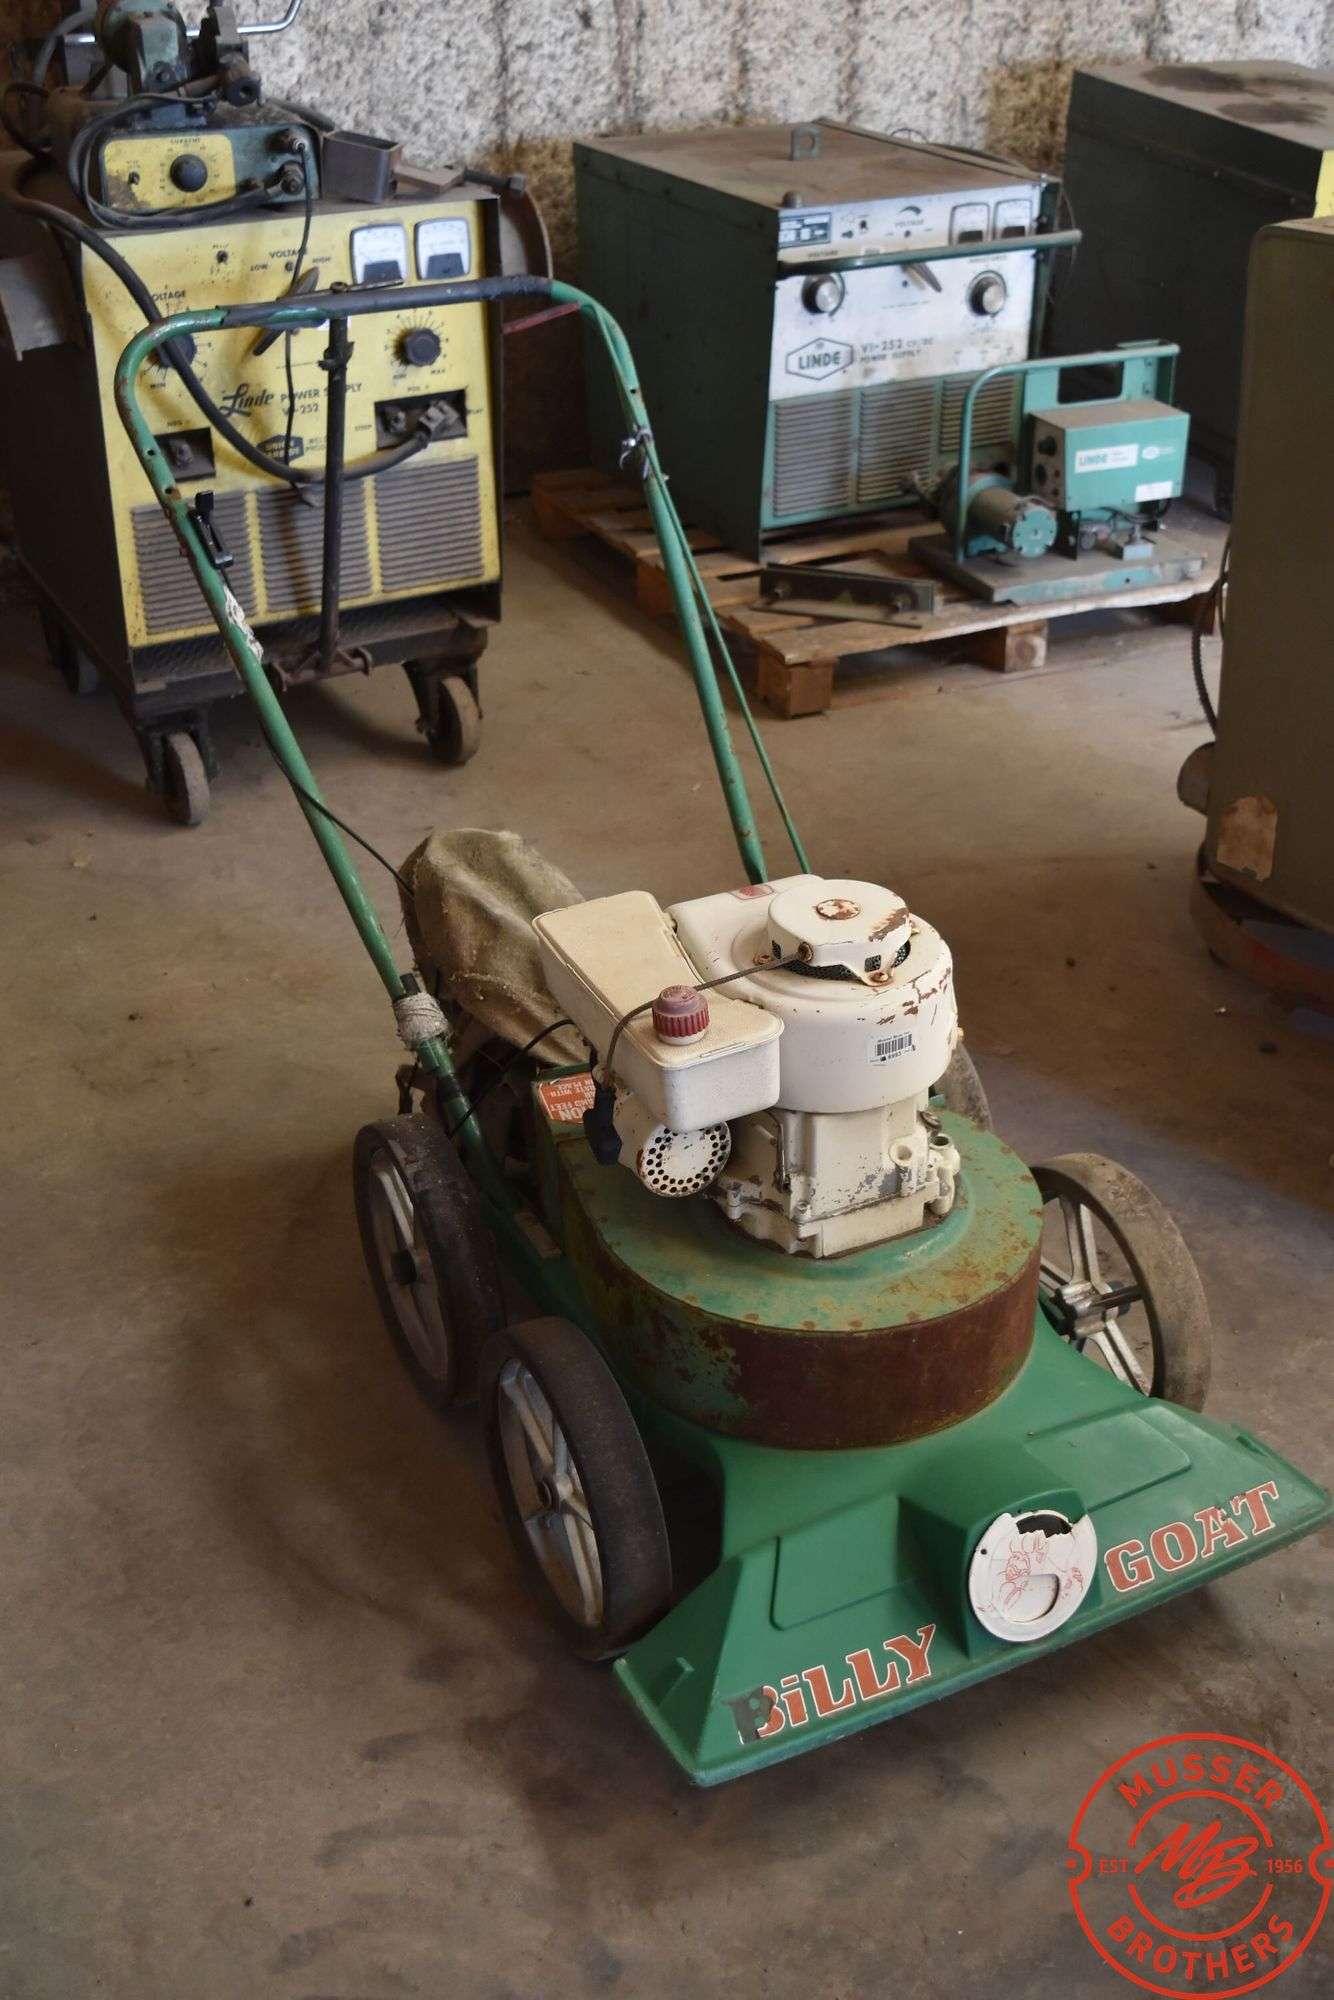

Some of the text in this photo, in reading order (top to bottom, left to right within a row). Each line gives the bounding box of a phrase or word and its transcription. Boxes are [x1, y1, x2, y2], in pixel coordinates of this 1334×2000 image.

[269, 247, 309, 258] VOLTAE
[153, 290, 187, 301] OLTAGE
[798, 351, 841, 370] LINDE
[220, 383, 274, 418] Linde
[1104, 1481, 1280, 1593] GOAT
